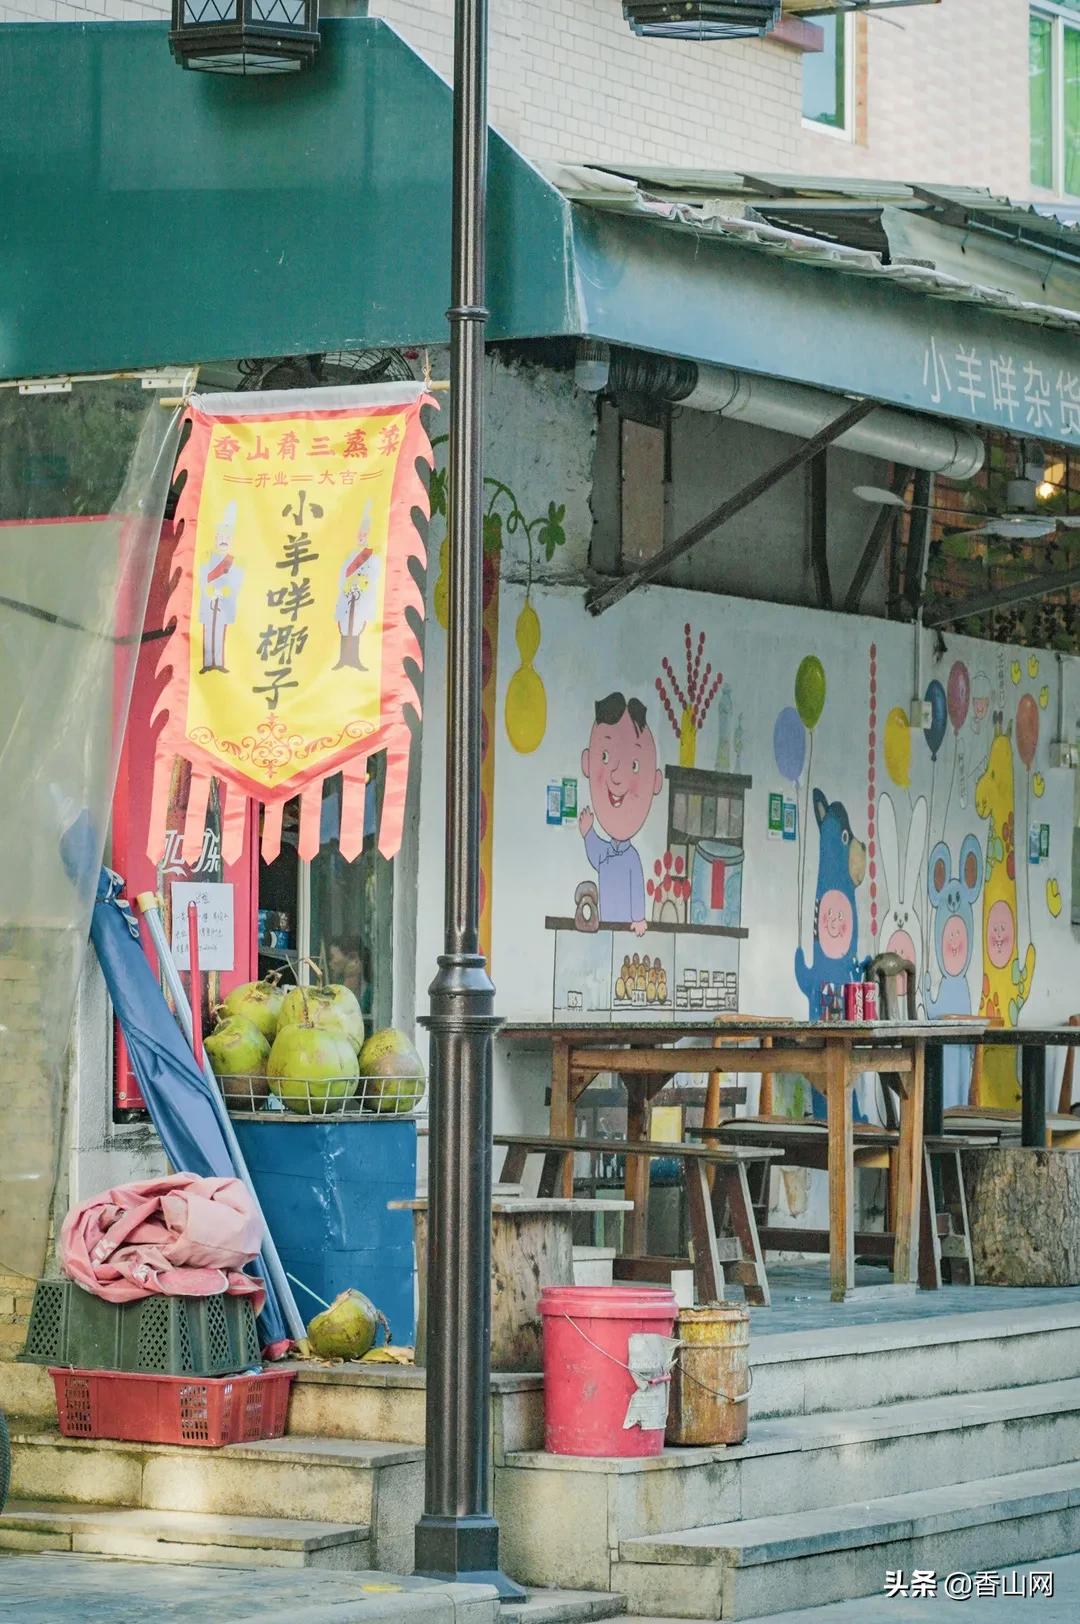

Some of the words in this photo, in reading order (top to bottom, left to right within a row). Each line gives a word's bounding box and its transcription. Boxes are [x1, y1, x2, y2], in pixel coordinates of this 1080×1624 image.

[922, 335, 1080, 435] 小羊咩杂货
[252, 489, 324, 710] 小羊咩椰子
